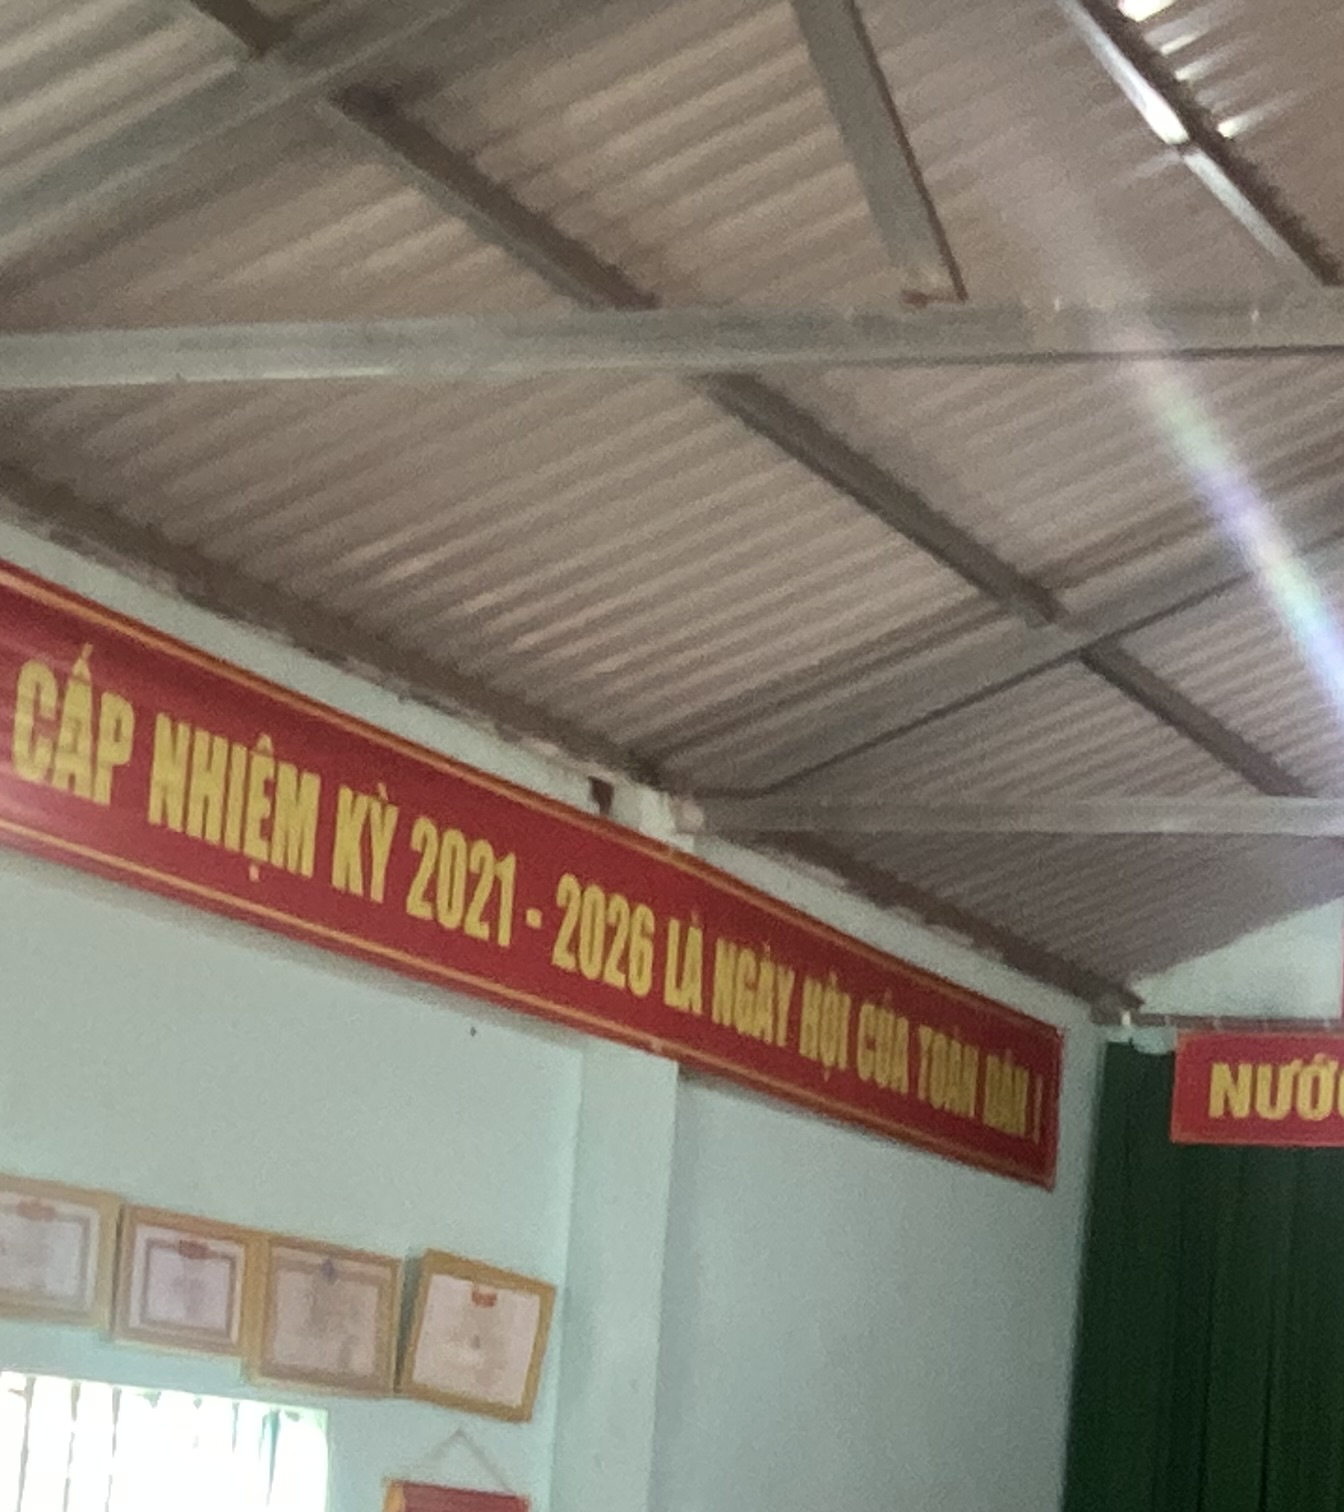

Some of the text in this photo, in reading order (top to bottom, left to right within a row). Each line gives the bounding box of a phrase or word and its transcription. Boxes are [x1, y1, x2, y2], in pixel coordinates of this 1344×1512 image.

[11, 642, 135, 806] CẤP
[148, 712, 321, 881] NHIỆM
[331, 783, 399, 903] KỲ
[406, 816, 516, 947] 2021
[526, 908, 541, 928] -
[552, 873, 655, 997] 2026
[664, 911, 703, 1015] LÀ
[712, 941, 795, 1047] NGÀY
